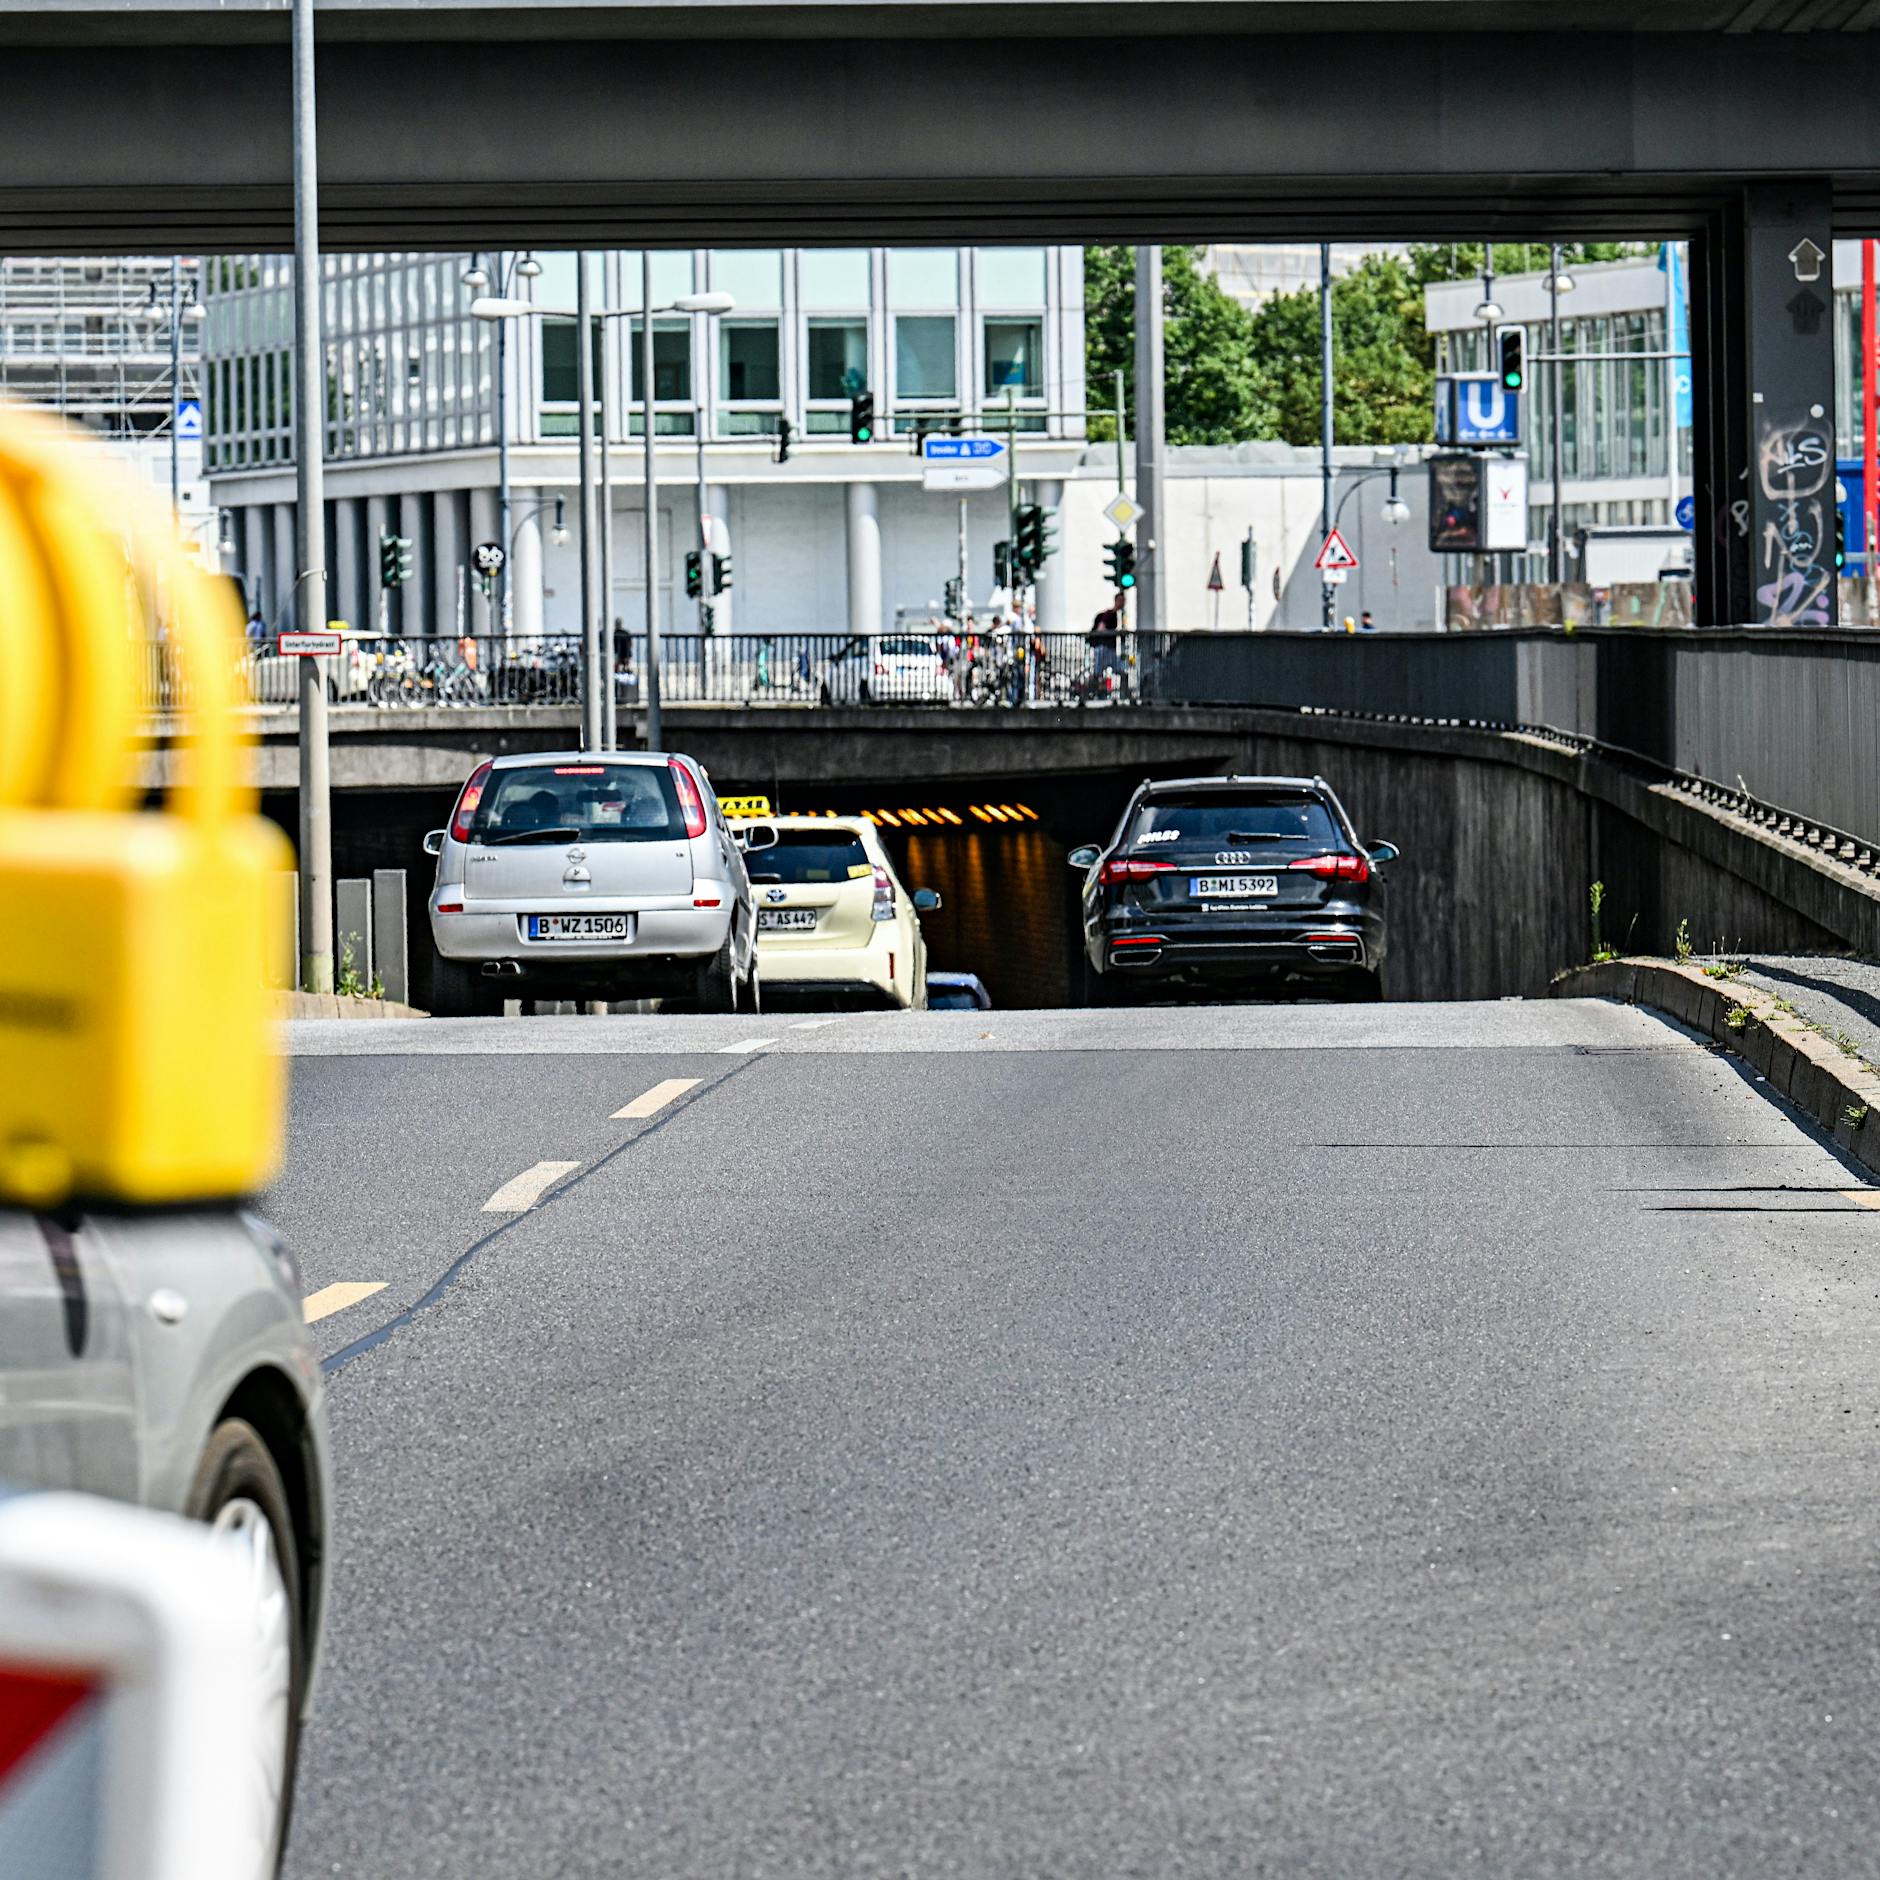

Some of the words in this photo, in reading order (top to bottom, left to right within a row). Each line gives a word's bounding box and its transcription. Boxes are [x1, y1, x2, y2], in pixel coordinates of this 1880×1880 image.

[1467, 382, 1505, 430] U
[1200, 880, 1209, 893] B
[1239, 878, 1275, 892] 5392
[539, 919, 550, 934] B
[584, 918, 624, 933] 1506
